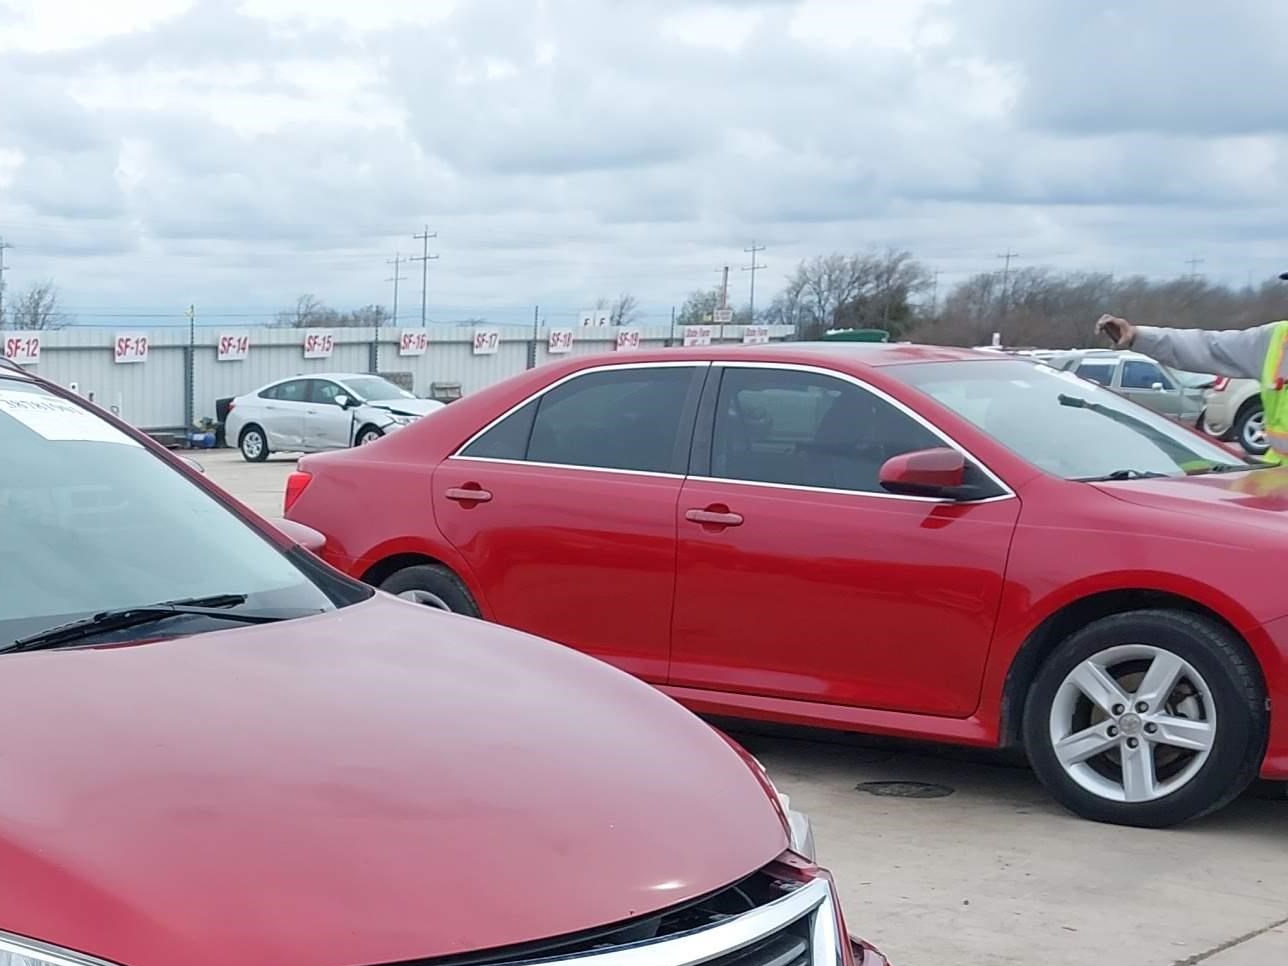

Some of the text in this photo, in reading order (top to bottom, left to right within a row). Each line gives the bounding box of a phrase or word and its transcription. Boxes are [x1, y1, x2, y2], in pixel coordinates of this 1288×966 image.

[6, 338, 40, 358] SF-12
[116, 337, 147, 357] SF-13
[220, 336, 248, 354] SF-14
[306, 335, 332, 352] SF-15
